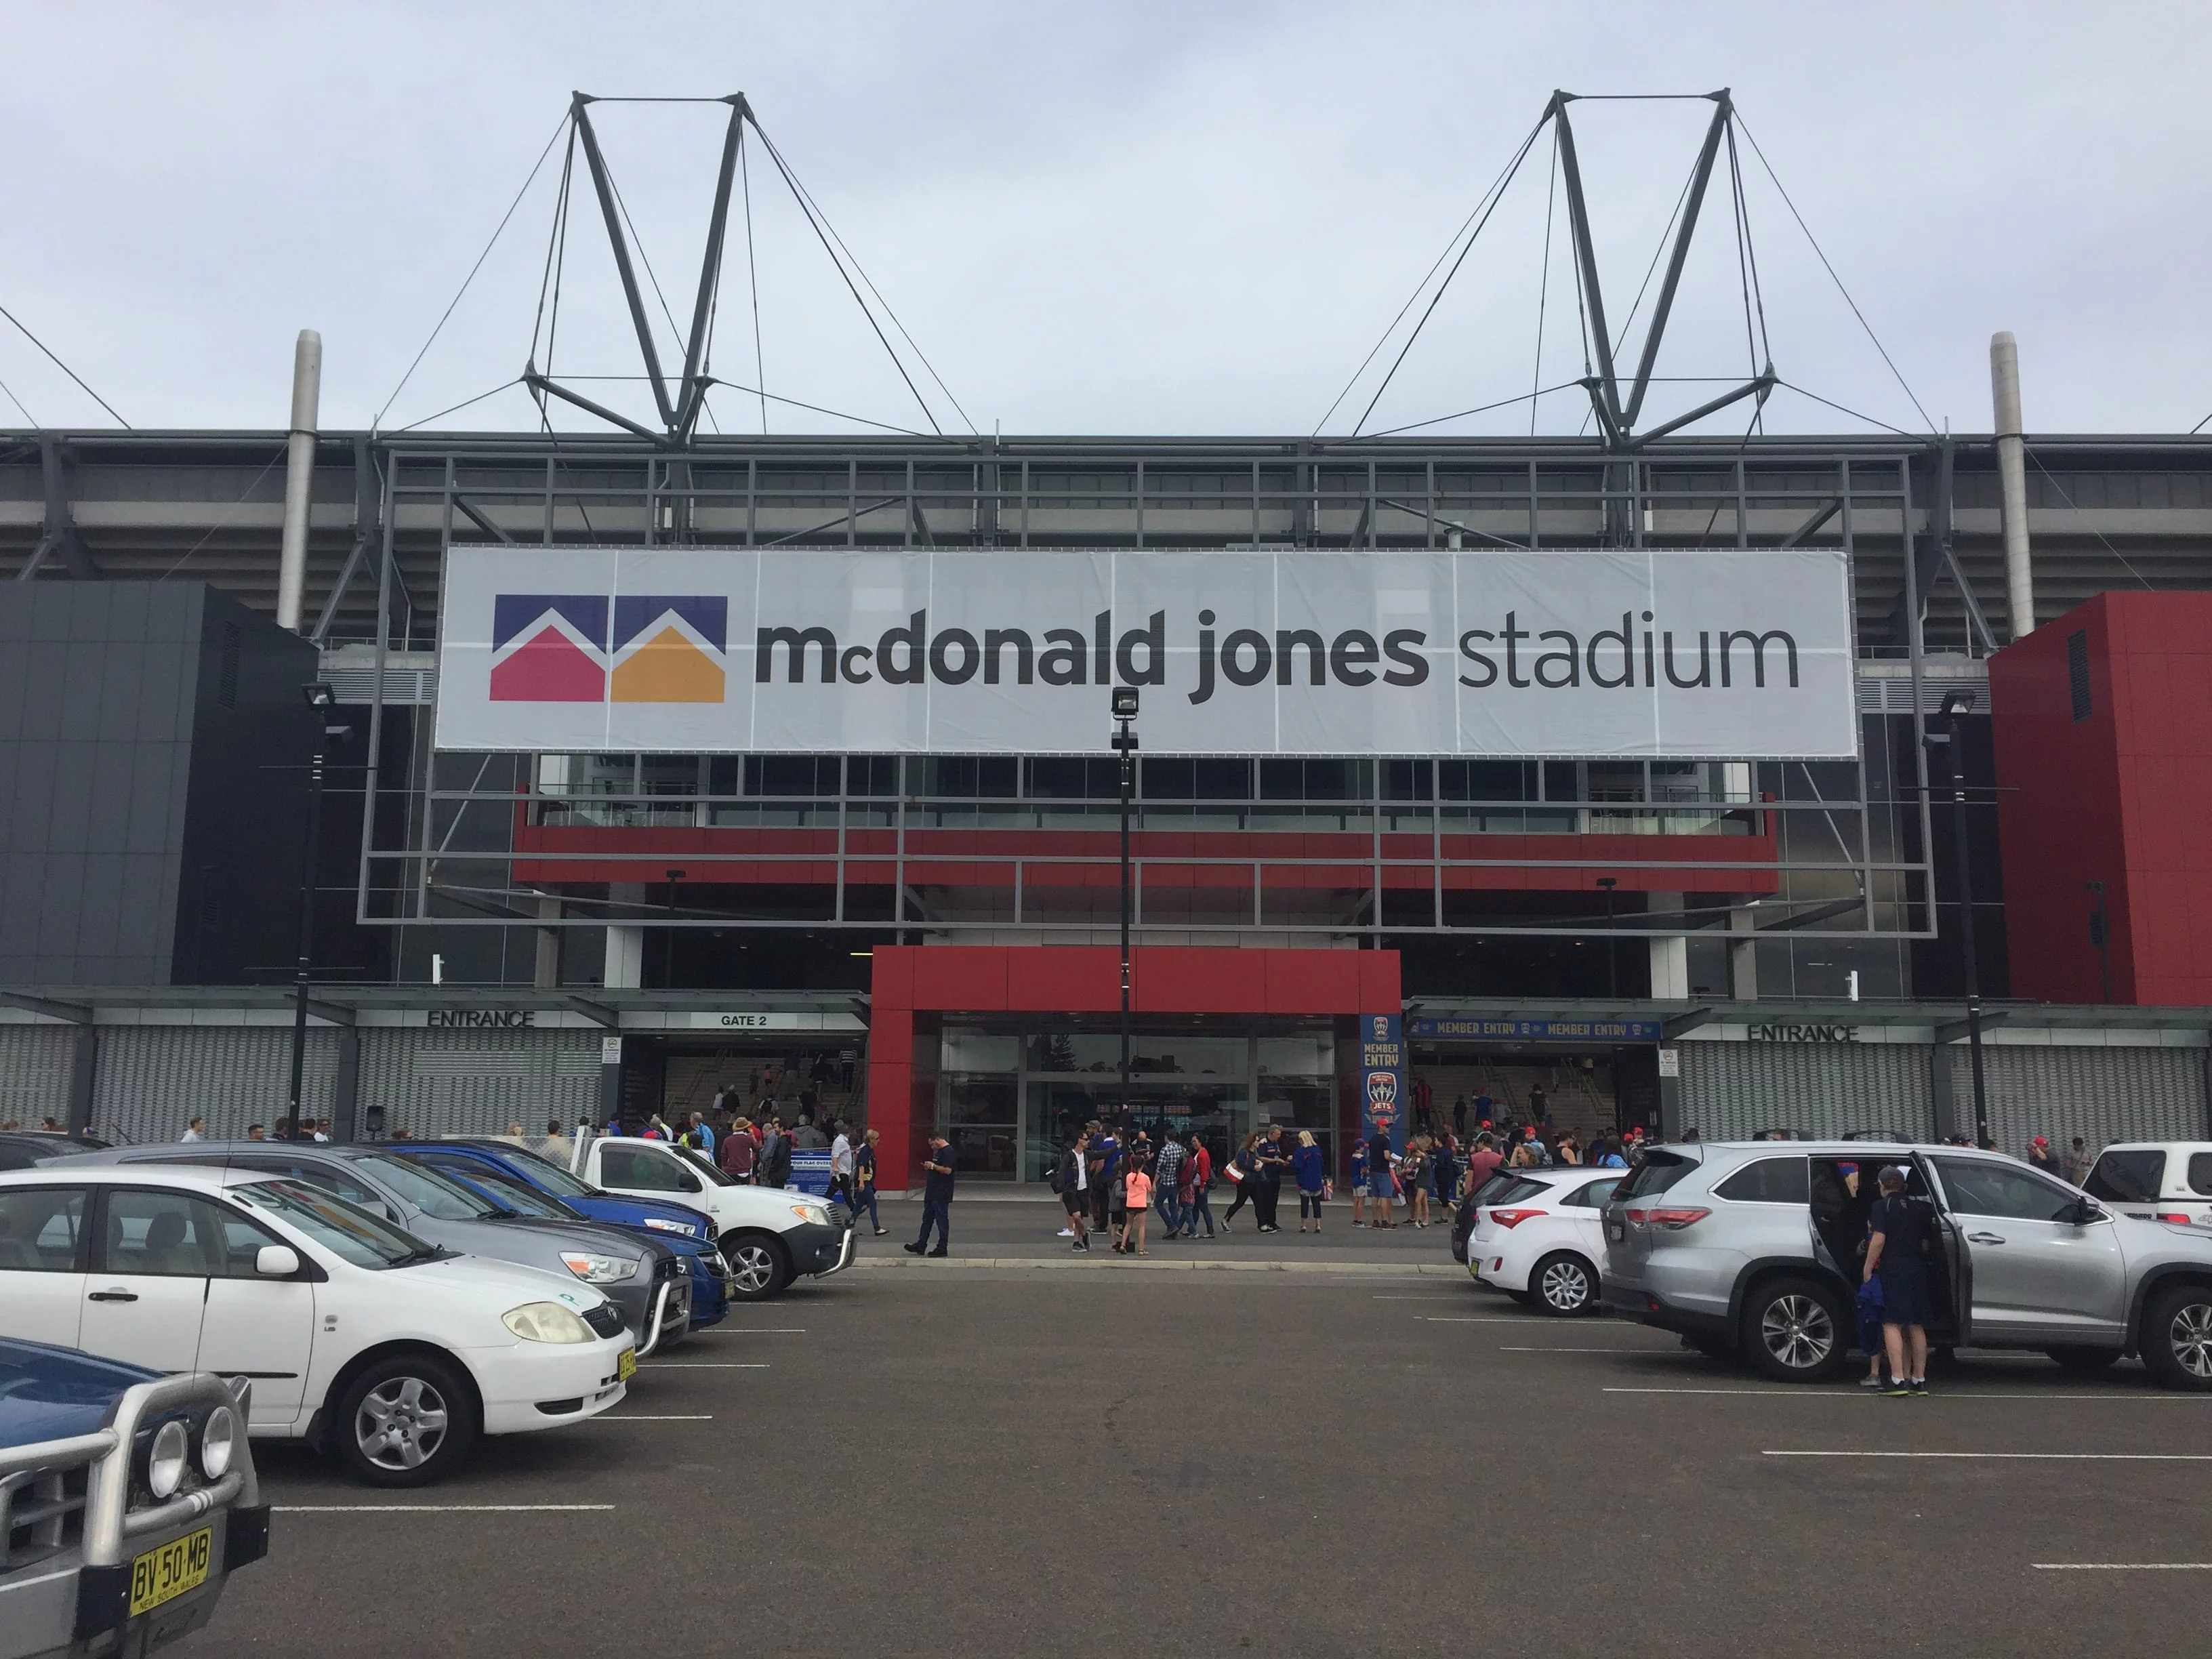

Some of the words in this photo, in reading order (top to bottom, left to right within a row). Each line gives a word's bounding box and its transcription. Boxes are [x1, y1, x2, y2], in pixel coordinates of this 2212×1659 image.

[755, 608, 1165, 686] mcdonald
[1188, 609, 1430, 705] jones
[1458, 611, 1799, 689] stadium
[427, 1010, 535, 1027] ENTRANCE
[721, 1016, 755, 1025] GATE
[758, 1016, 767, 1026] 2
[1437, 1022, 1479, 1033] MEMBER
[1483, 1023, 1515, 1034] ENTRY
[1548, 1024, 1590, 1036] MEMBER
[1595, 1024, 1626, 1036] ENTRY
[1748, 1024, 1860, 1043] ENTRANCE
[1364, 1044, 1398, 1053] MEMBER
[1365, 1054, 1399, 1066] ENTRY
[139, 1597, 155, 1609] NEW
[158, 1586, 178, 1603] SOUTH
[180, 1574, 199, 1590] WALES
